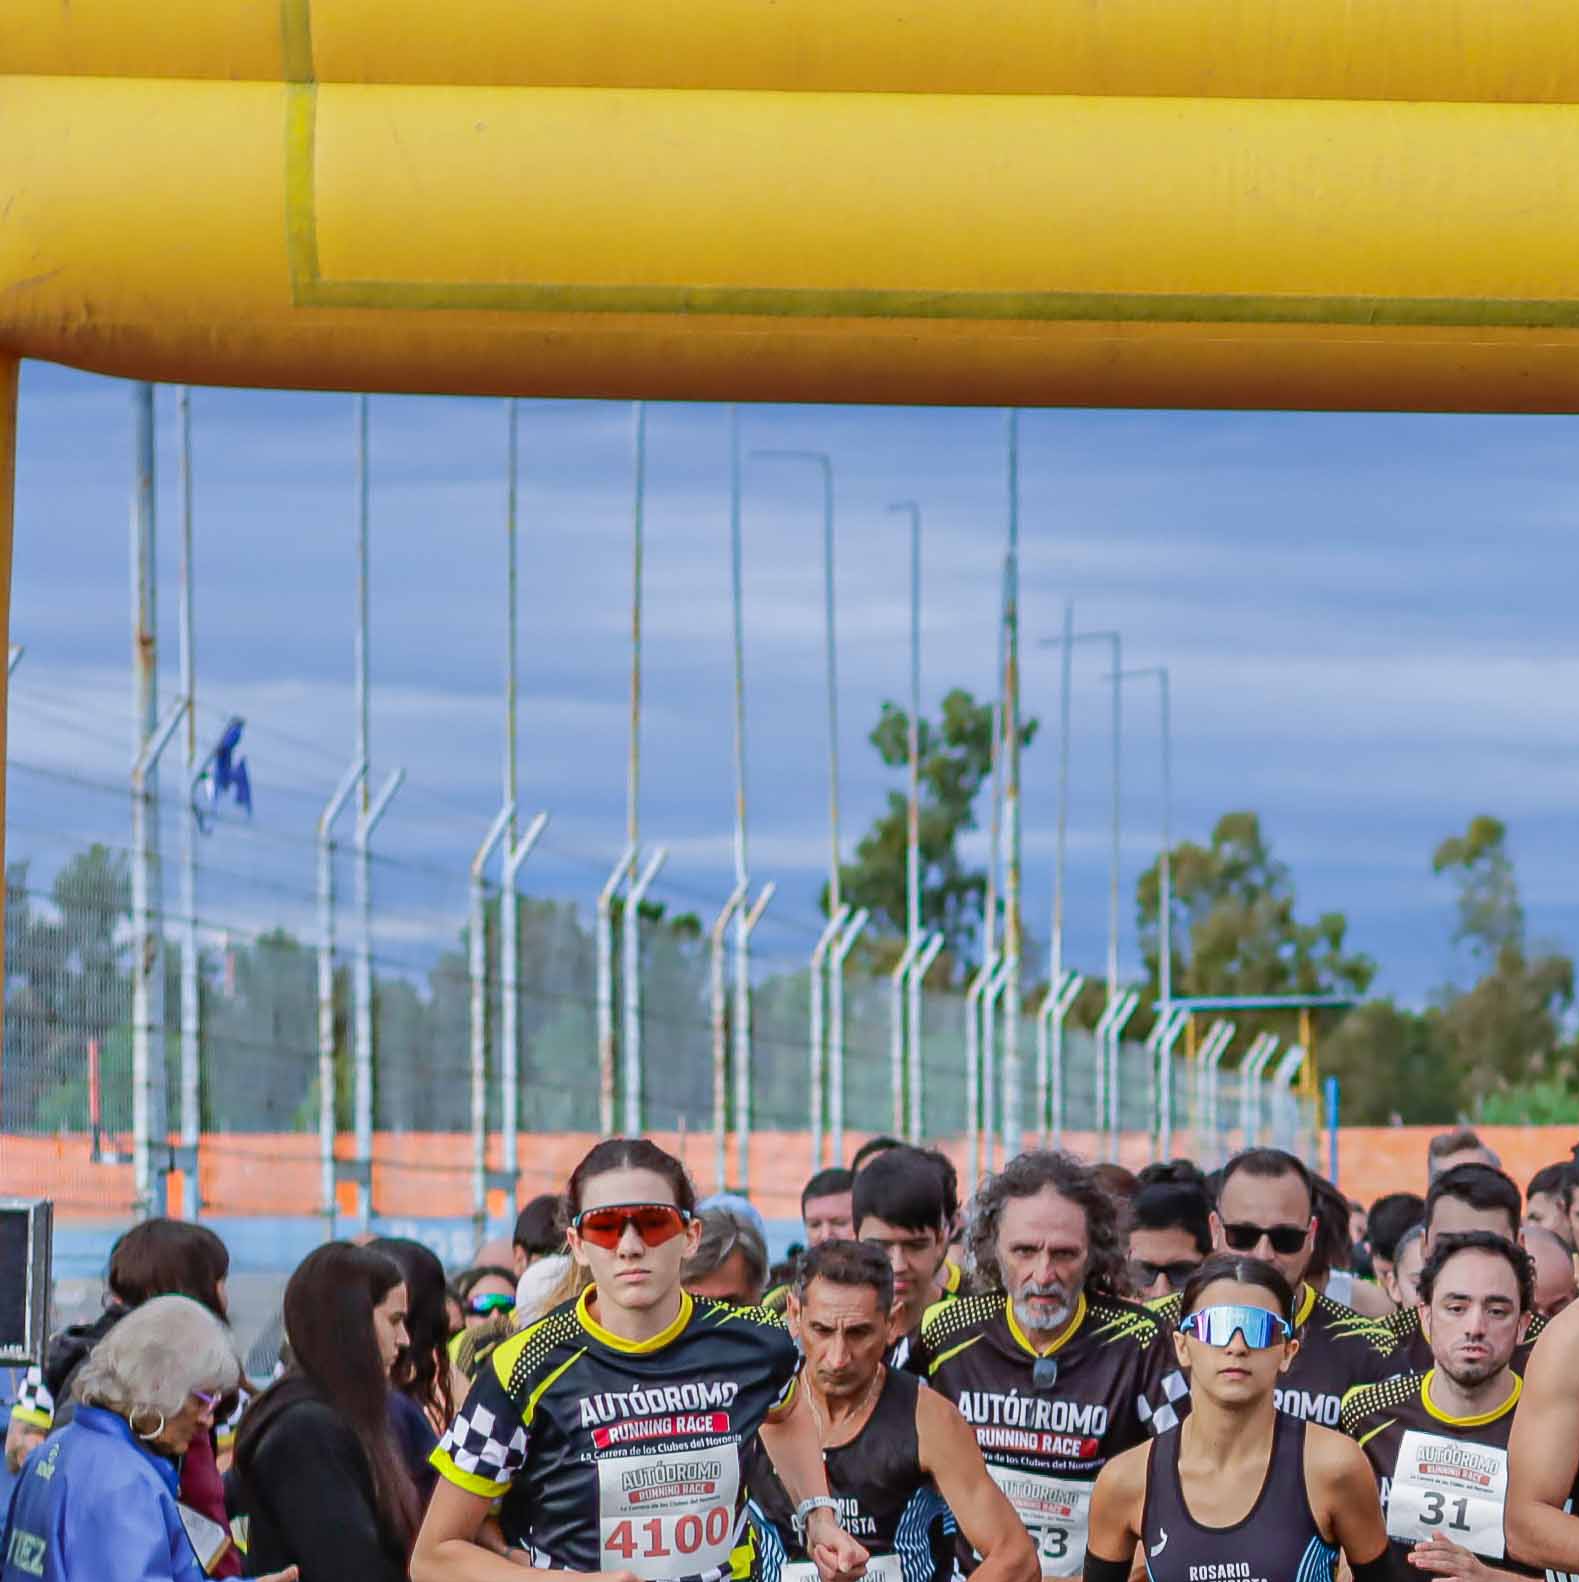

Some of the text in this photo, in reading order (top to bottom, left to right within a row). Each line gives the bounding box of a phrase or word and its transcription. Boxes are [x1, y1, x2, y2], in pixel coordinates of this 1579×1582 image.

[579, 1382, 738, 1428] AUTÓDROMO
[609, 1415, 714, 1443] RUNNING RACE
[976, 1429, 1081, 1456] RUNNING RACE
[630, 1446, 641, 1456] de
[643, 1444, 656, 1455] los
[658, 1441, 688, 1454] Clubes
[691, 1437, 705, 1449] del
[1416, 1443, 1500, 1475] AUTÓDROMO
[622, 1460, 721, 1491] AUTÓDROMO
[1006, 1455, 1019, 1465] los
[1052, 1459, 1067, 1470] del
[1419, 1491, 1471, 1532] 31
[605, 1506, 729, 1559] 4100
[1189, 1562, 1250, 1582] ROSARIO
